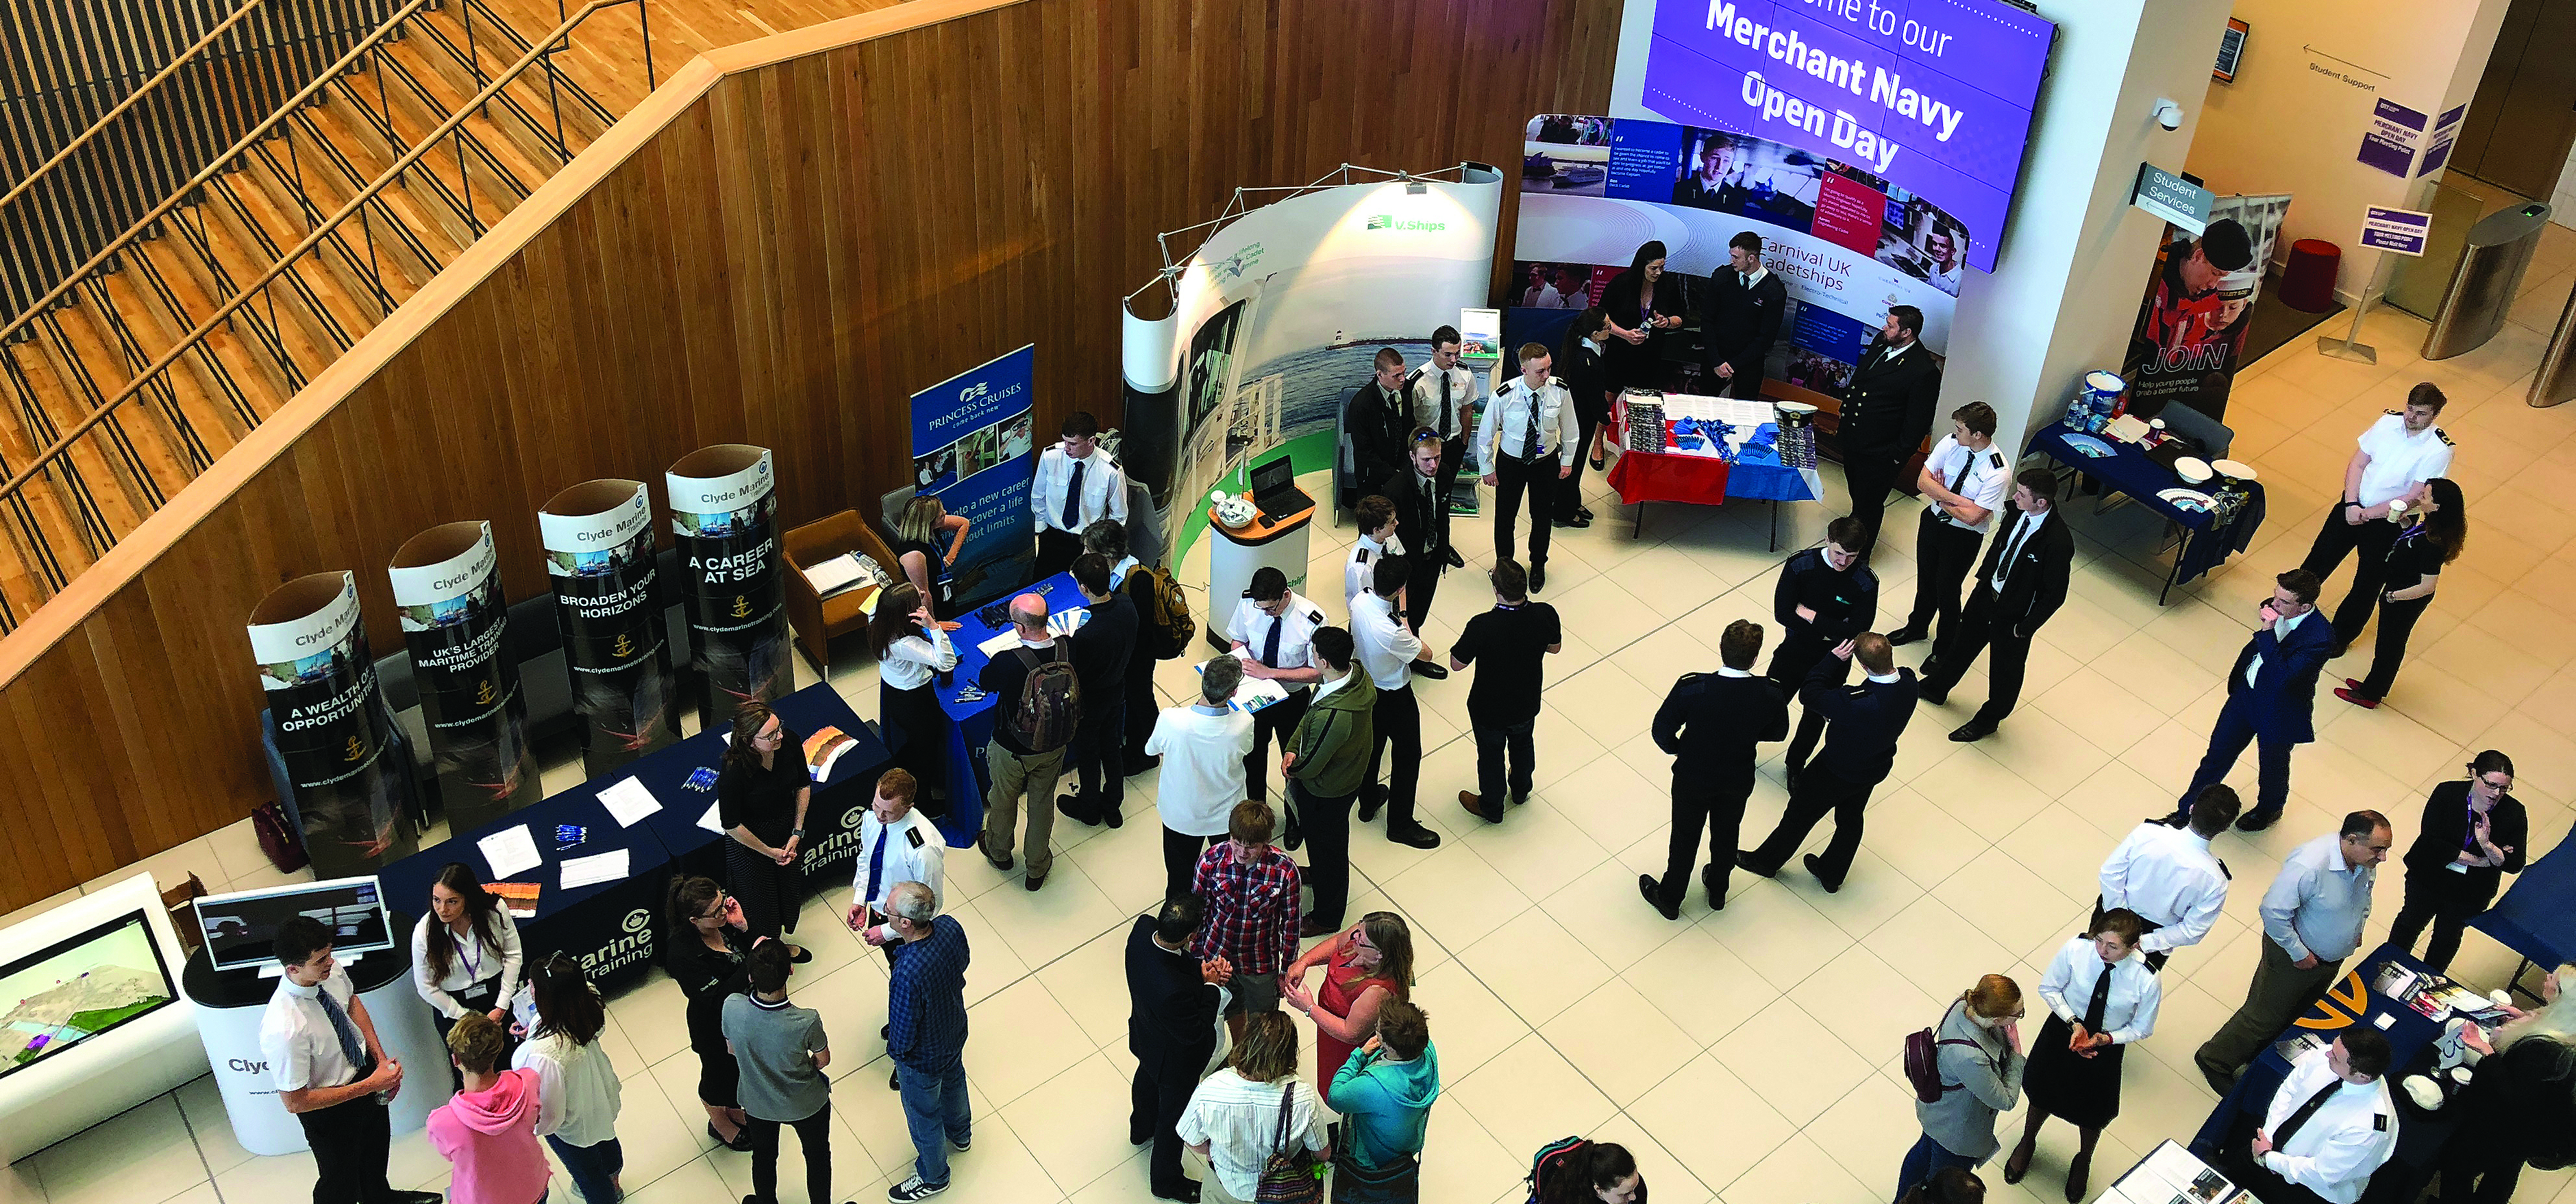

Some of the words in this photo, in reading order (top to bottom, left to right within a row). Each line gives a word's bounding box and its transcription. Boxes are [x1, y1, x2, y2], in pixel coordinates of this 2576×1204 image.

[1868, 0, 1895, 36] to
[1903, 18, 1953, 58] our
[1705, 0, 1867, 95] Merchant
[1870, 66, 1963, 142] Navy
[2309, 62, 2341, 79] Student
[2342, 75, 2375, 92] Support
[1741, 70, 1826, 137] Open
[1831, 107, 1900, 173] Day
[2373, 119, 2403, 134] MERCHANT
[2403, 130, 2418, 140] NAVY
[2381, 129, 2396, 139] OPEN
[2396, 134, 2407, 144] DAY
[2149, 186, 2196, 214] Services
[2154, 173, 2197, 199] Student
[1760, 253, 1844, 291] adetships
[1827, 257, 1852, 278] UK
[2142, 344, 2228, 375] JOIN
[2155, 379, 2174, 388] young
[2175, 377, 2198, 388] people
[929, 401, 977, 431] PRINCESS
[979, 382, 1021, 407] CRUISES
[952, 418, 969, 429] come
[970, 410, 985, 420] back
[701, 492, 736, 505] Clyde
[739, 473, 769, 496] Marine
[971, 501, 976, 510] a
[979, 492, 999, 507] new
[1002, 477, 1030, 497] career
[1000, 504, 1006, 512] a
[1008, 495, 1024, 509] life
[577, 529, 613, 542] Clyde
[616, 505, 646, 533] Marine
[627, 515, 647, 534] Training
[987, 515, 1015, 533] limits
[689, 557, 701, 569] A
[706, 538, 773, 570] CAREER
[433, 572, 469, 592] Clyde
[704, 571, 727, 583] AT
[733, 559, 765, 581] SEA
[560, 590, 628, 607] BROADEN
[630, 568, 656, 595] YOUR
[580, 590, 647, 618] HORIZONS
[295, 624, 332, 647] Clyde
[433, 646, 462, 658] UK'S
[464, 616, 501, 650] LARGEST
[419, 648, 477, 668] MARITIME
[450, 642, 499, 673] PROVIDER
[291, 709, 303, 720] A
[305, 681, 360, 716] WEALTH
[804, 826, 861, 864] arine
[579, 929, 652, 970] arine
